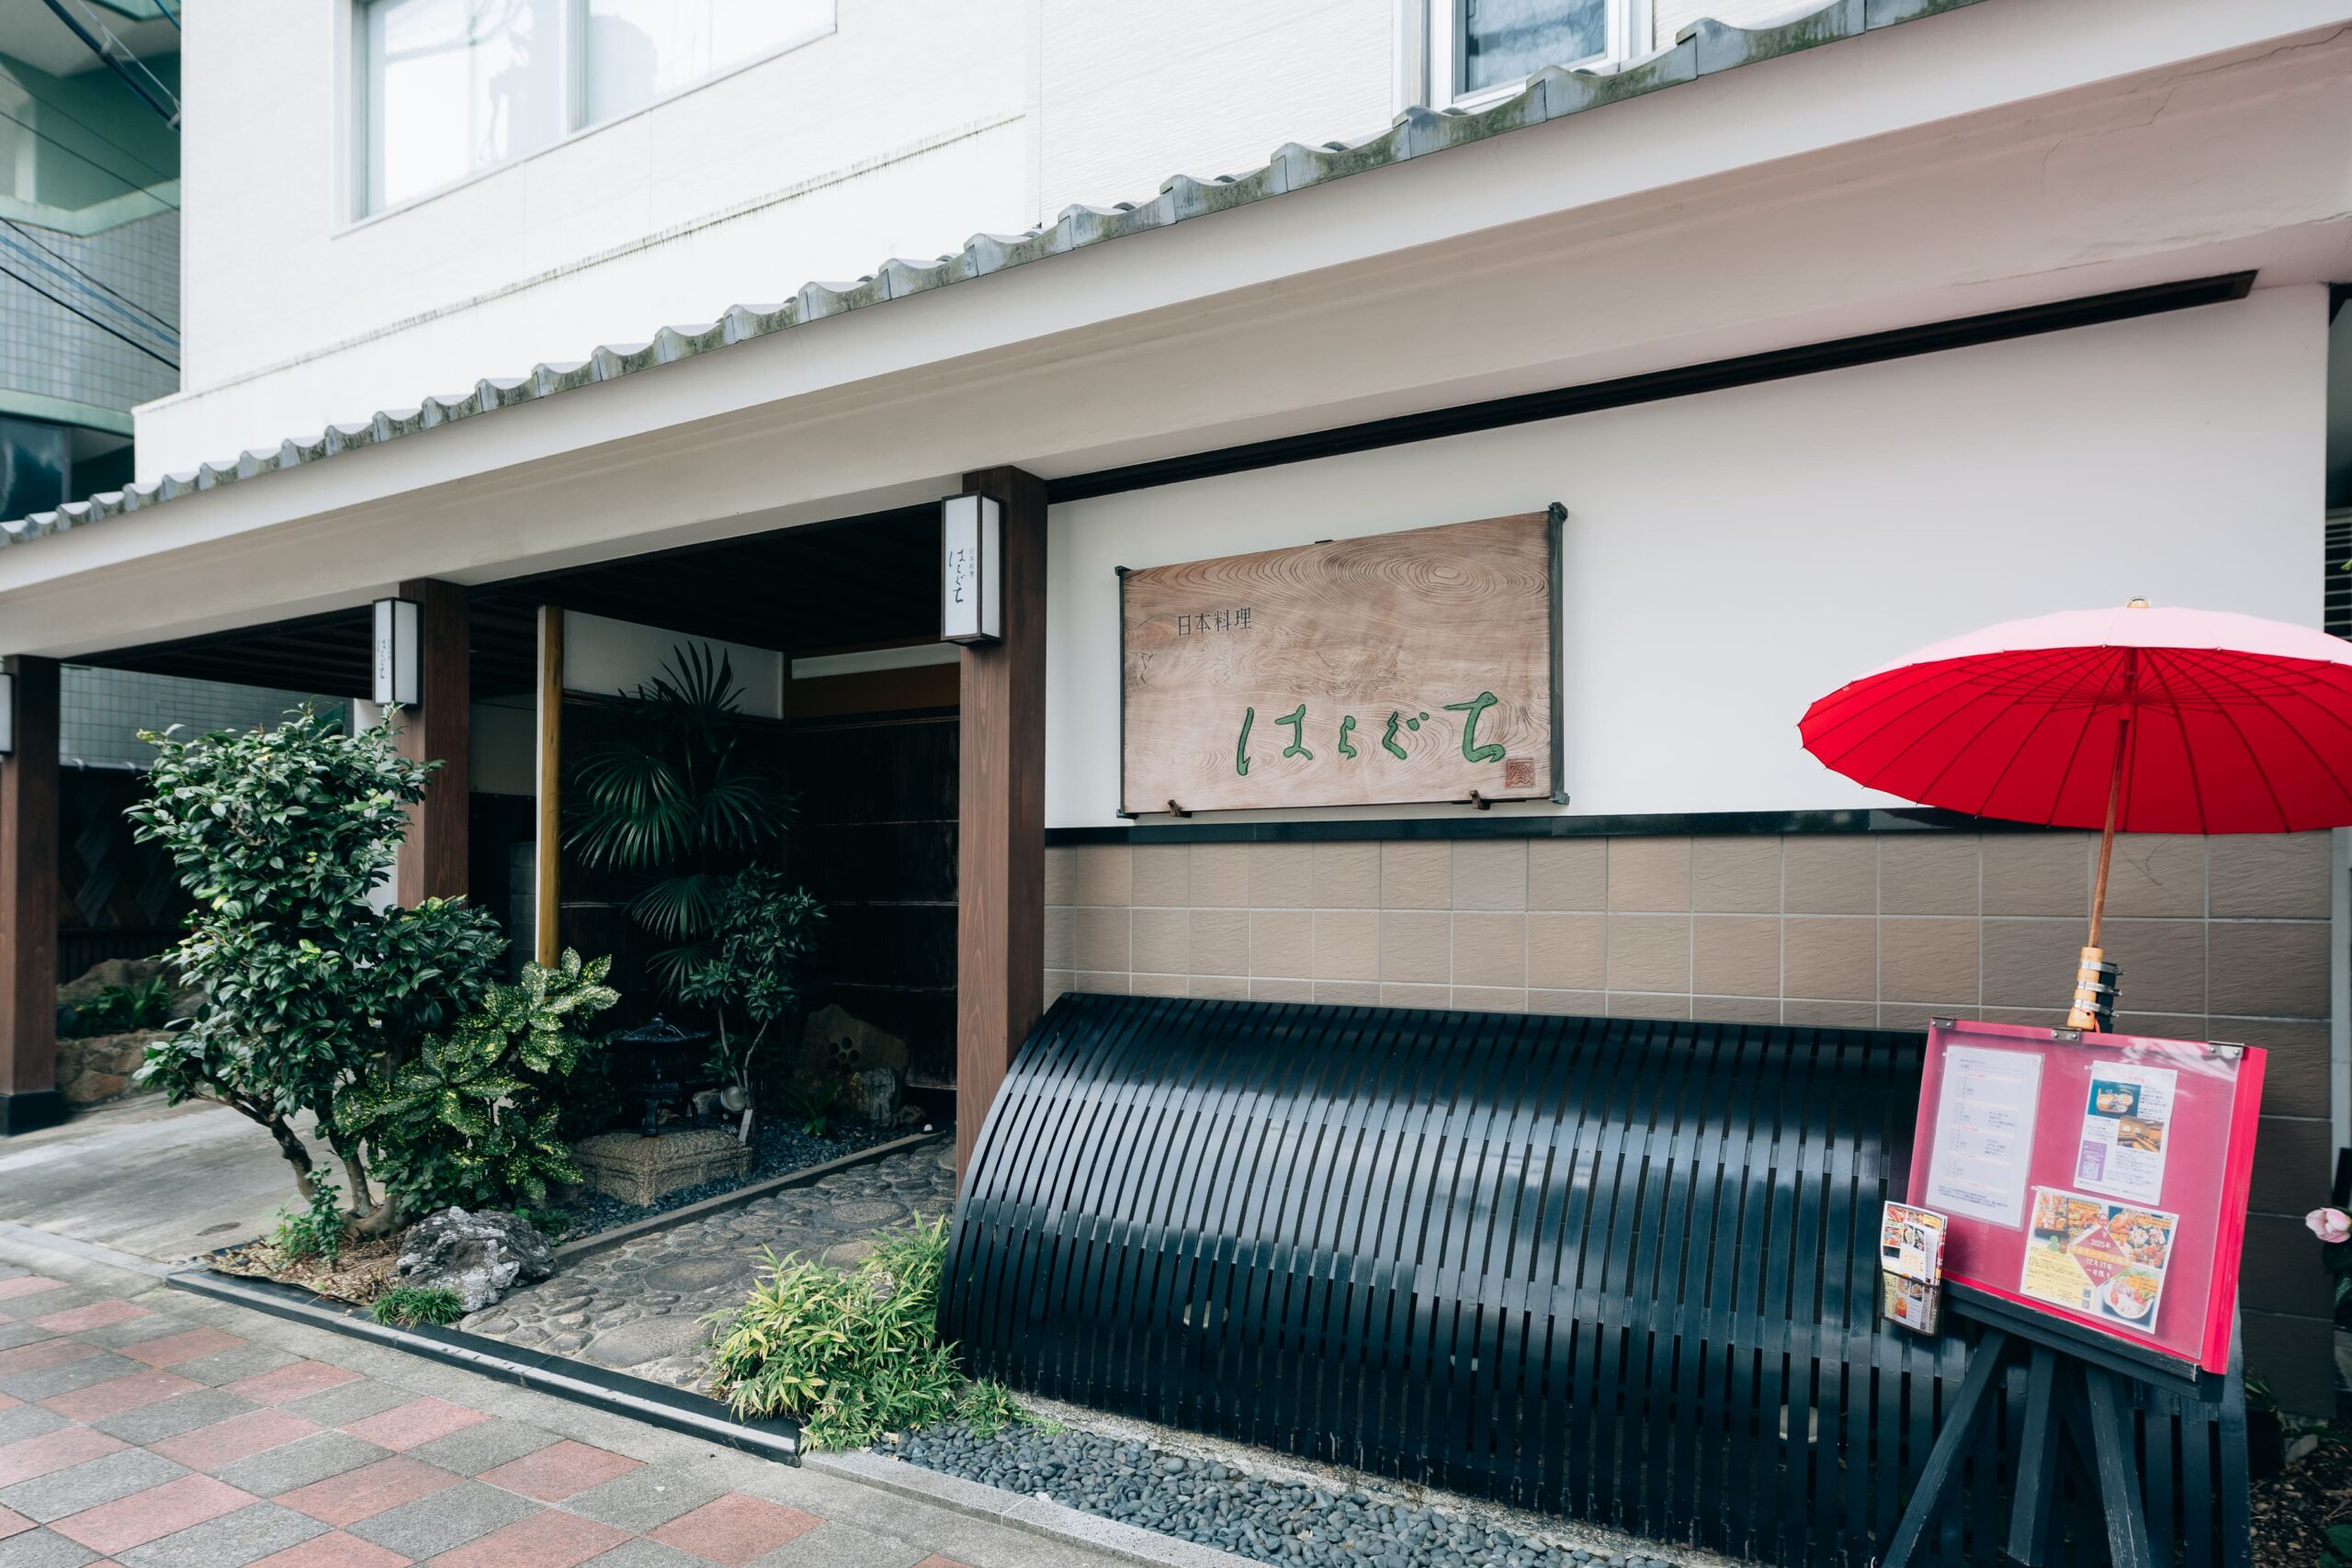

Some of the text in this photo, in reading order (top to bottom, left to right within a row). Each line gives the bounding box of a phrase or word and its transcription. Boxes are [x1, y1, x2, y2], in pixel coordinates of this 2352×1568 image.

[1177, 606, 1252, 637] 日本料理
[1236, 691, 1506, 776] はらぐち
[2090, 1238, 2111, 1250] 2025年
